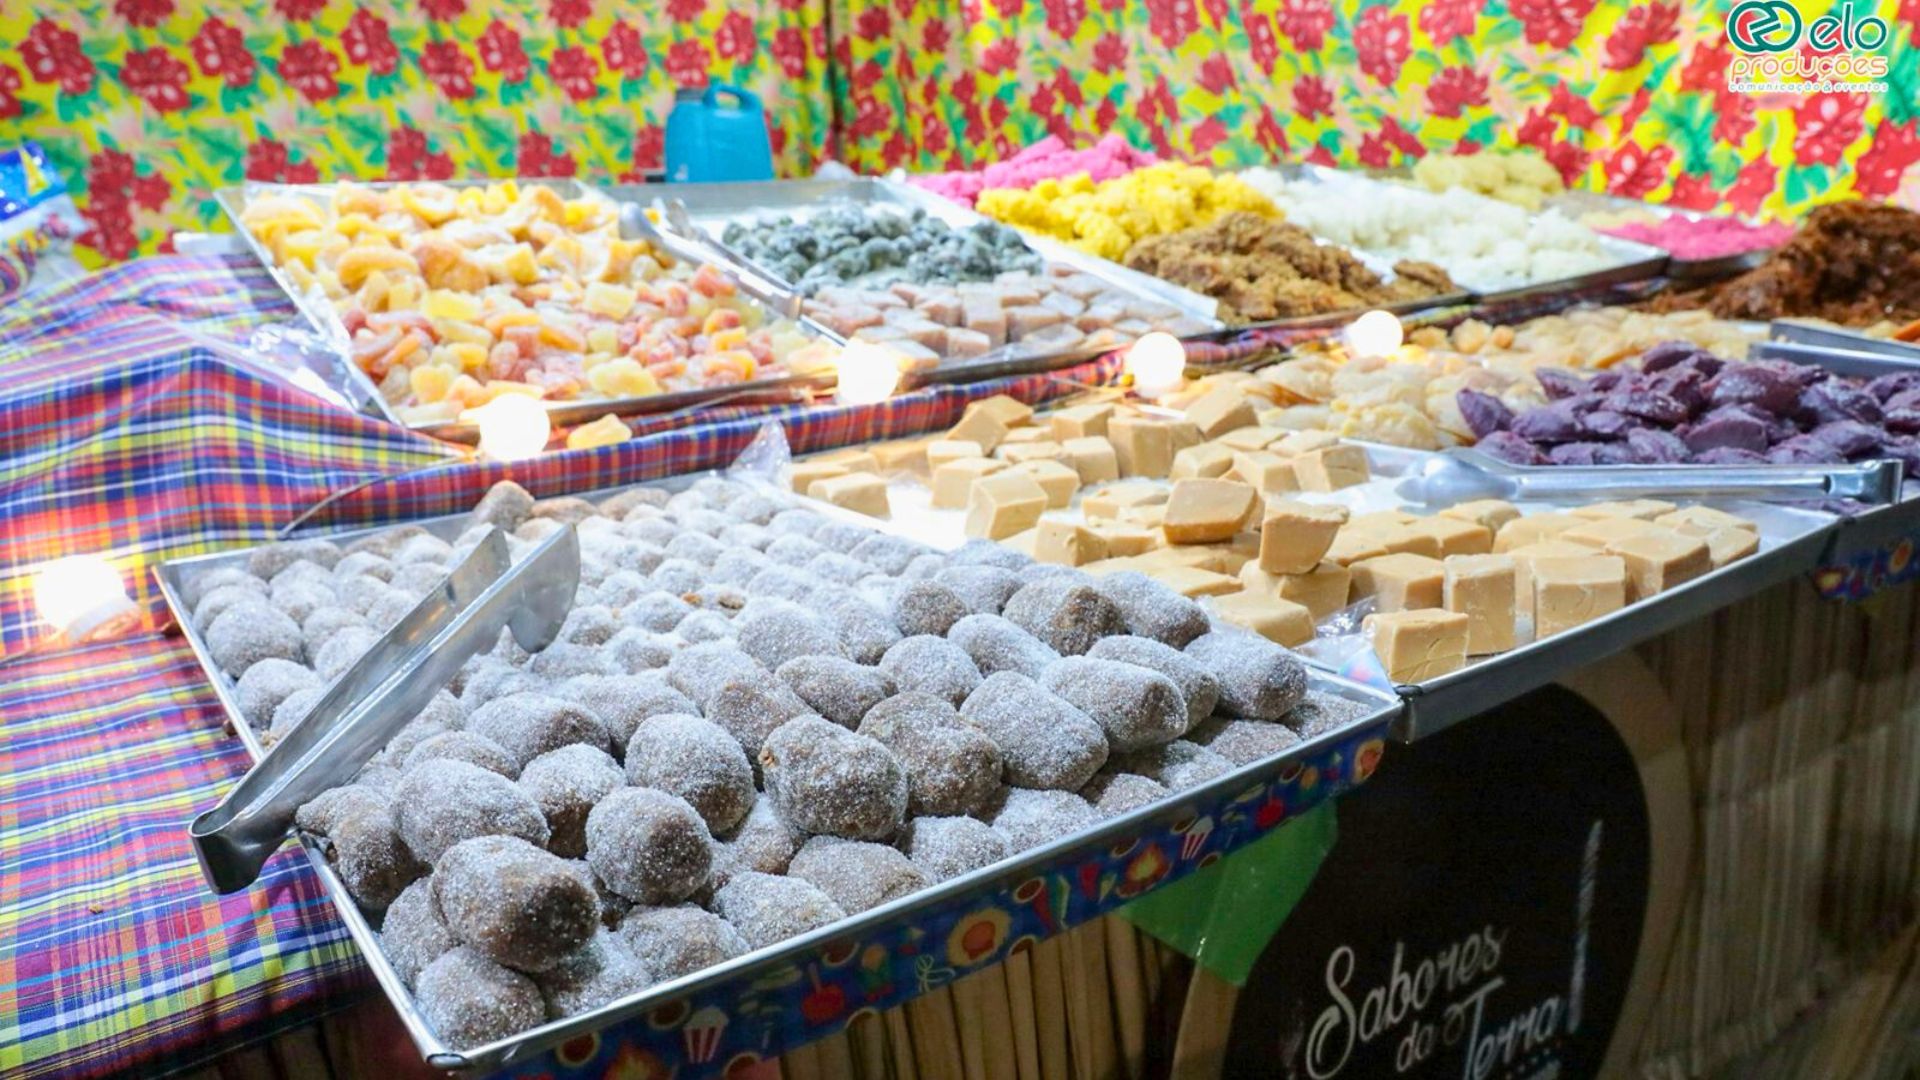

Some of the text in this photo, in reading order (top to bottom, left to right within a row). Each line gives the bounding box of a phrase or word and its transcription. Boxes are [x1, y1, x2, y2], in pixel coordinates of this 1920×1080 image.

[1305, 924, 1507, 1080] Sabores
[1395, 975, 1561, 1080] da Terra
